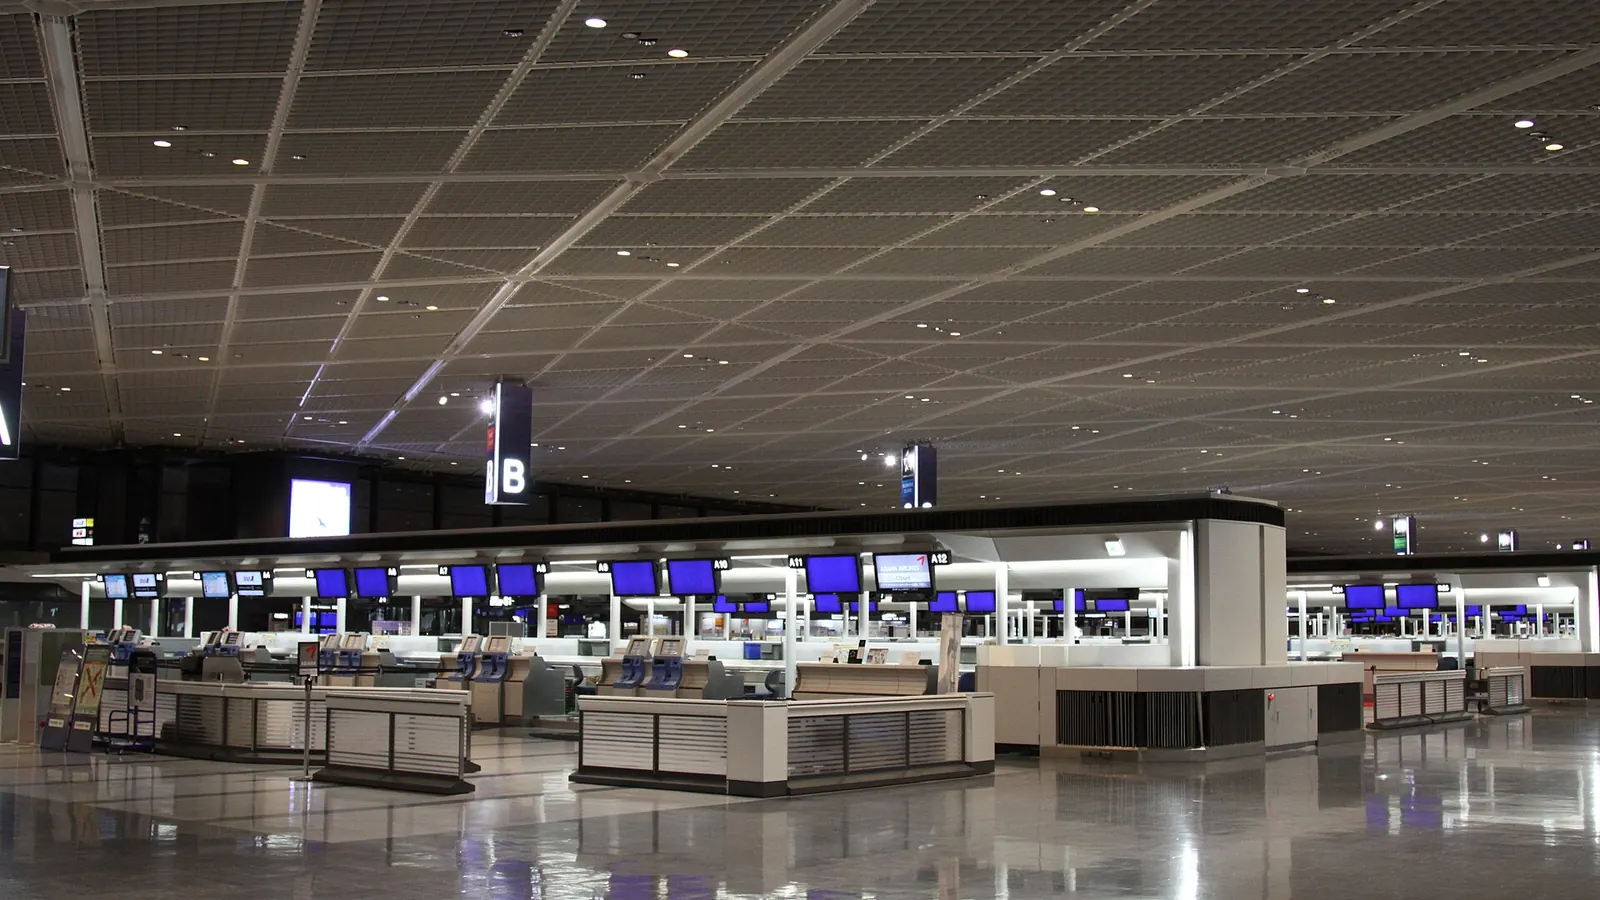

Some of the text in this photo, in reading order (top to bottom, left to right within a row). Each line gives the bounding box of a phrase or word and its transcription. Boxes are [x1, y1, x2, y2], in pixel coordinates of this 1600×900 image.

[503, 458, 525, 494] B
[789, 557, 803, 567] A11
[931, 553, 948, 564] A12
[598, 563, 609, 572] A9
[714, 560, 728, 569] A10
